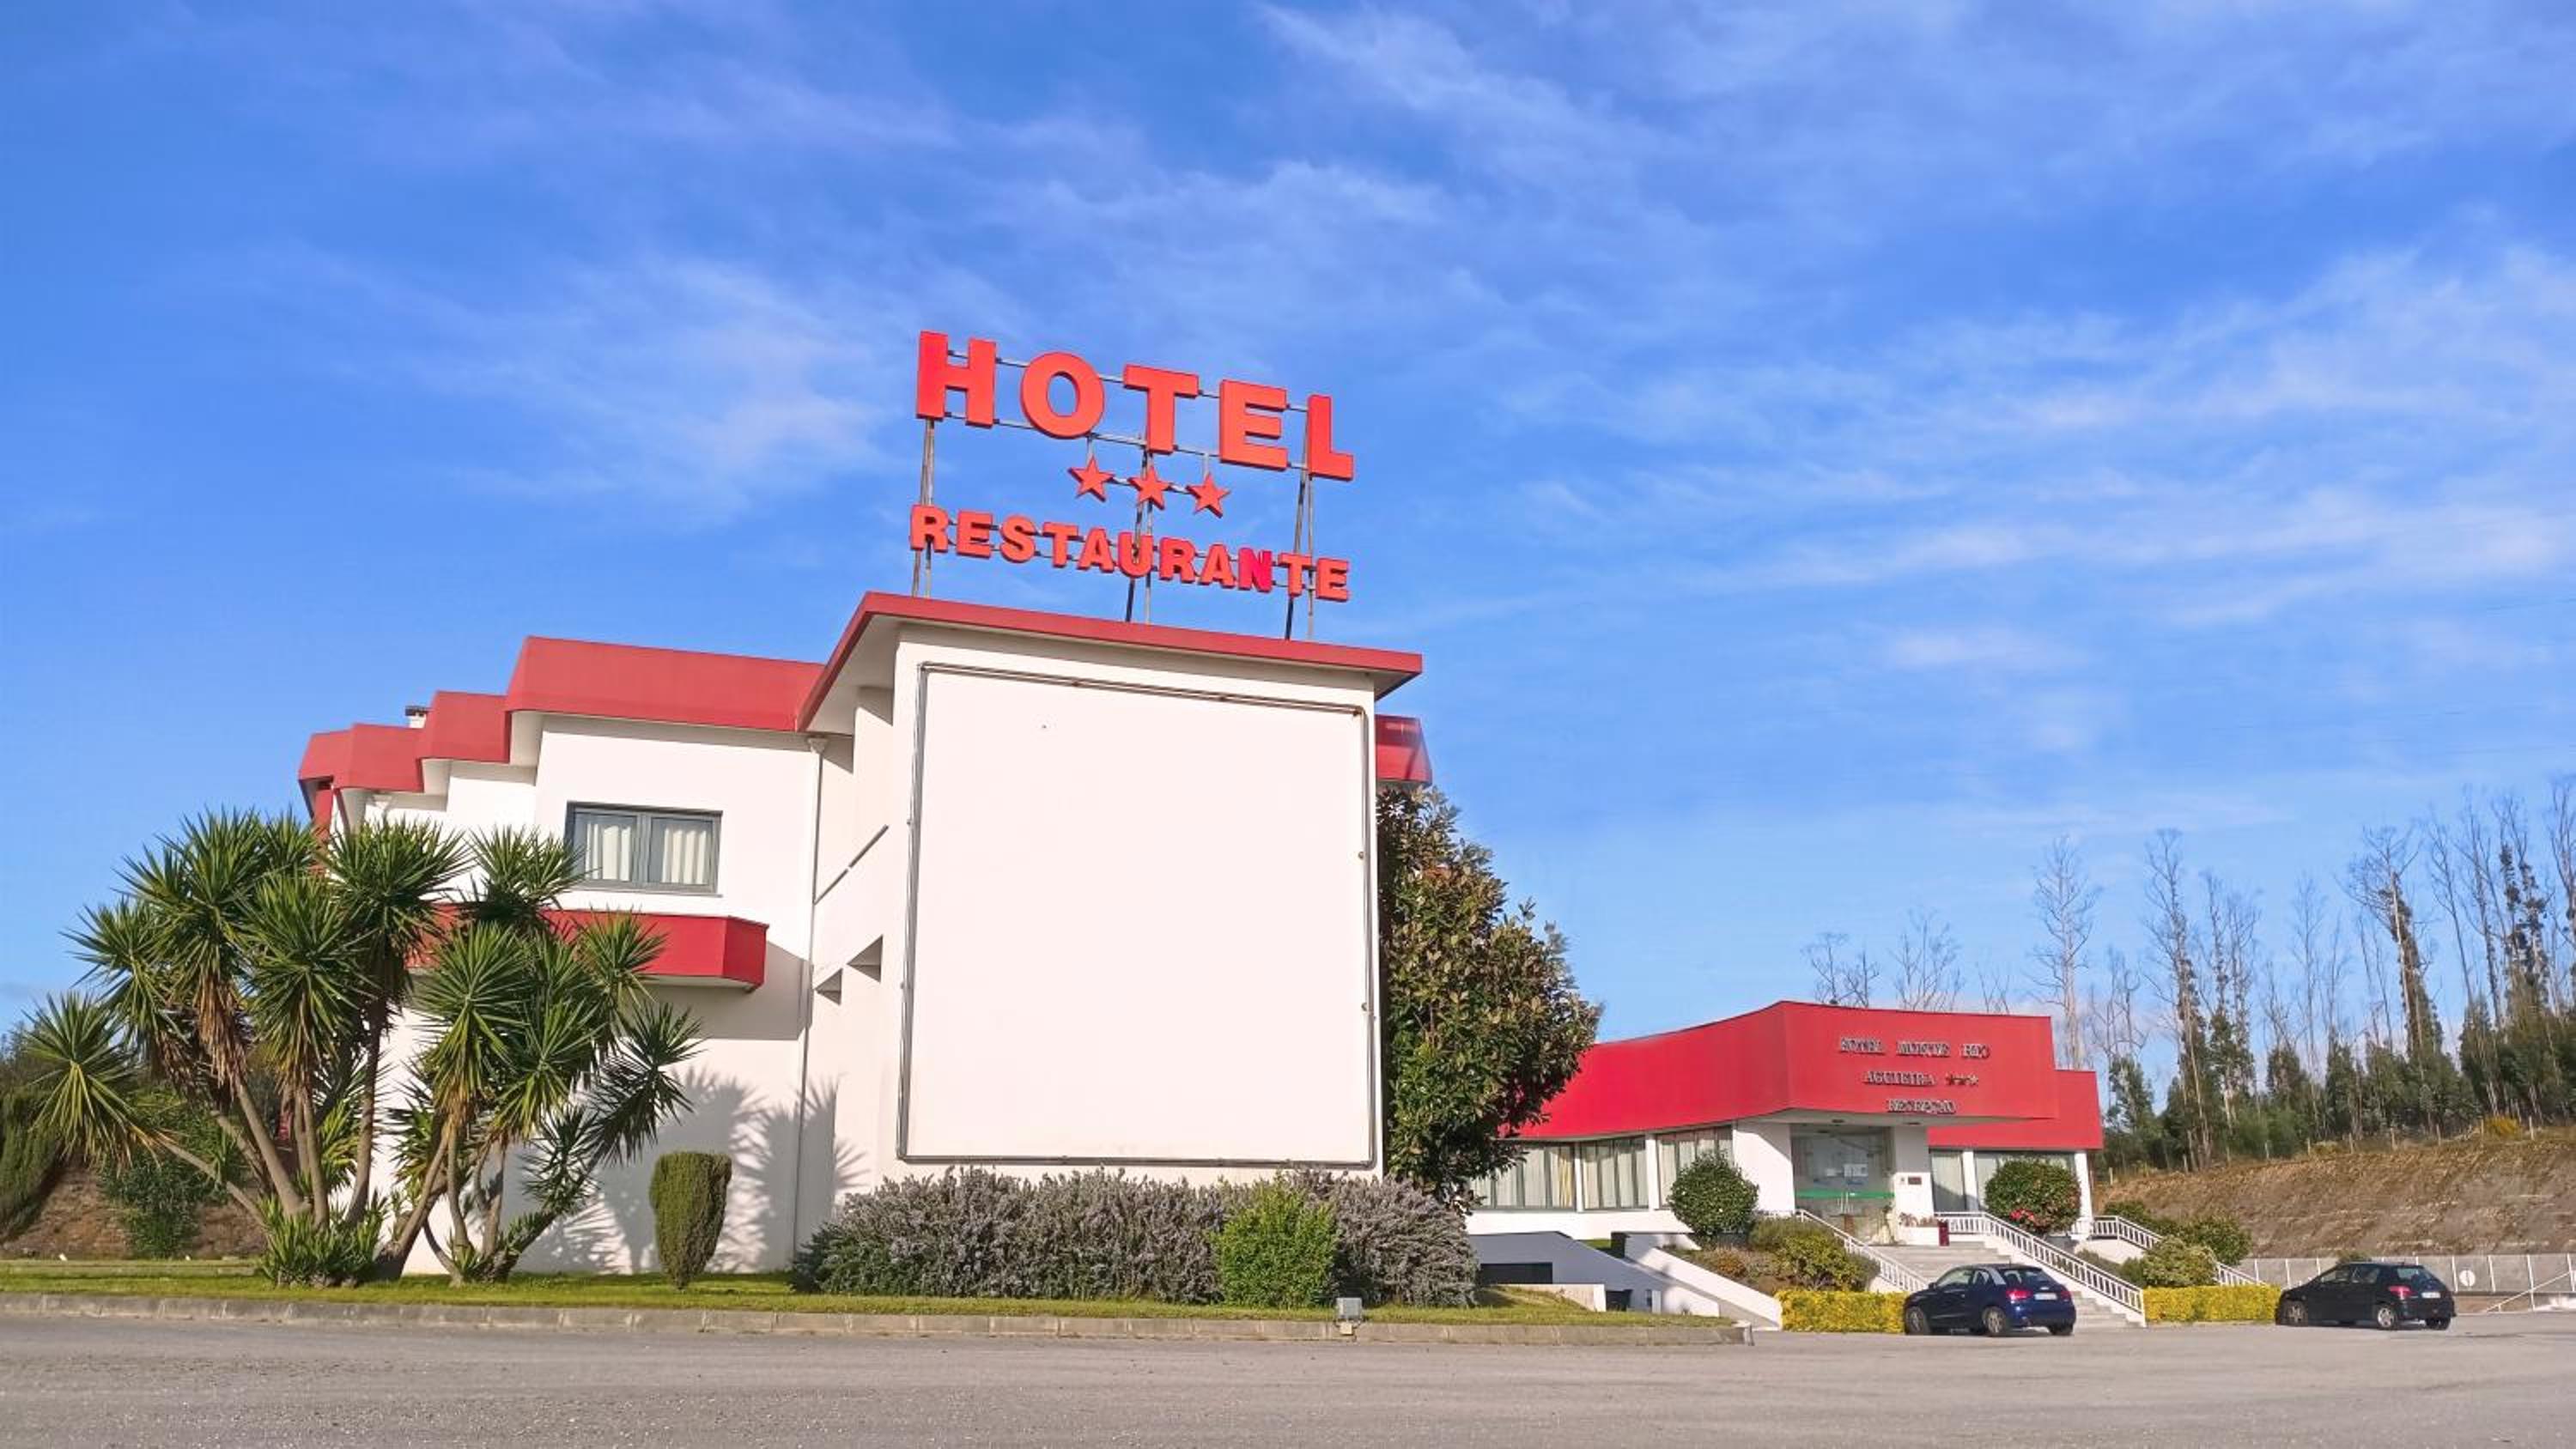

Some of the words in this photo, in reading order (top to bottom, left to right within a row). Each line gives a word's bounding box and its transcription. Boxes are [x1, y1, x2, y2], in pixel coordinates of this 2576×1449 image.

[916, 330, 1353, 481] HOTEL
[910, 504, 1349, 601] RESTAURANTE
[1839, 1036, 1884, 1054] HOTEL
